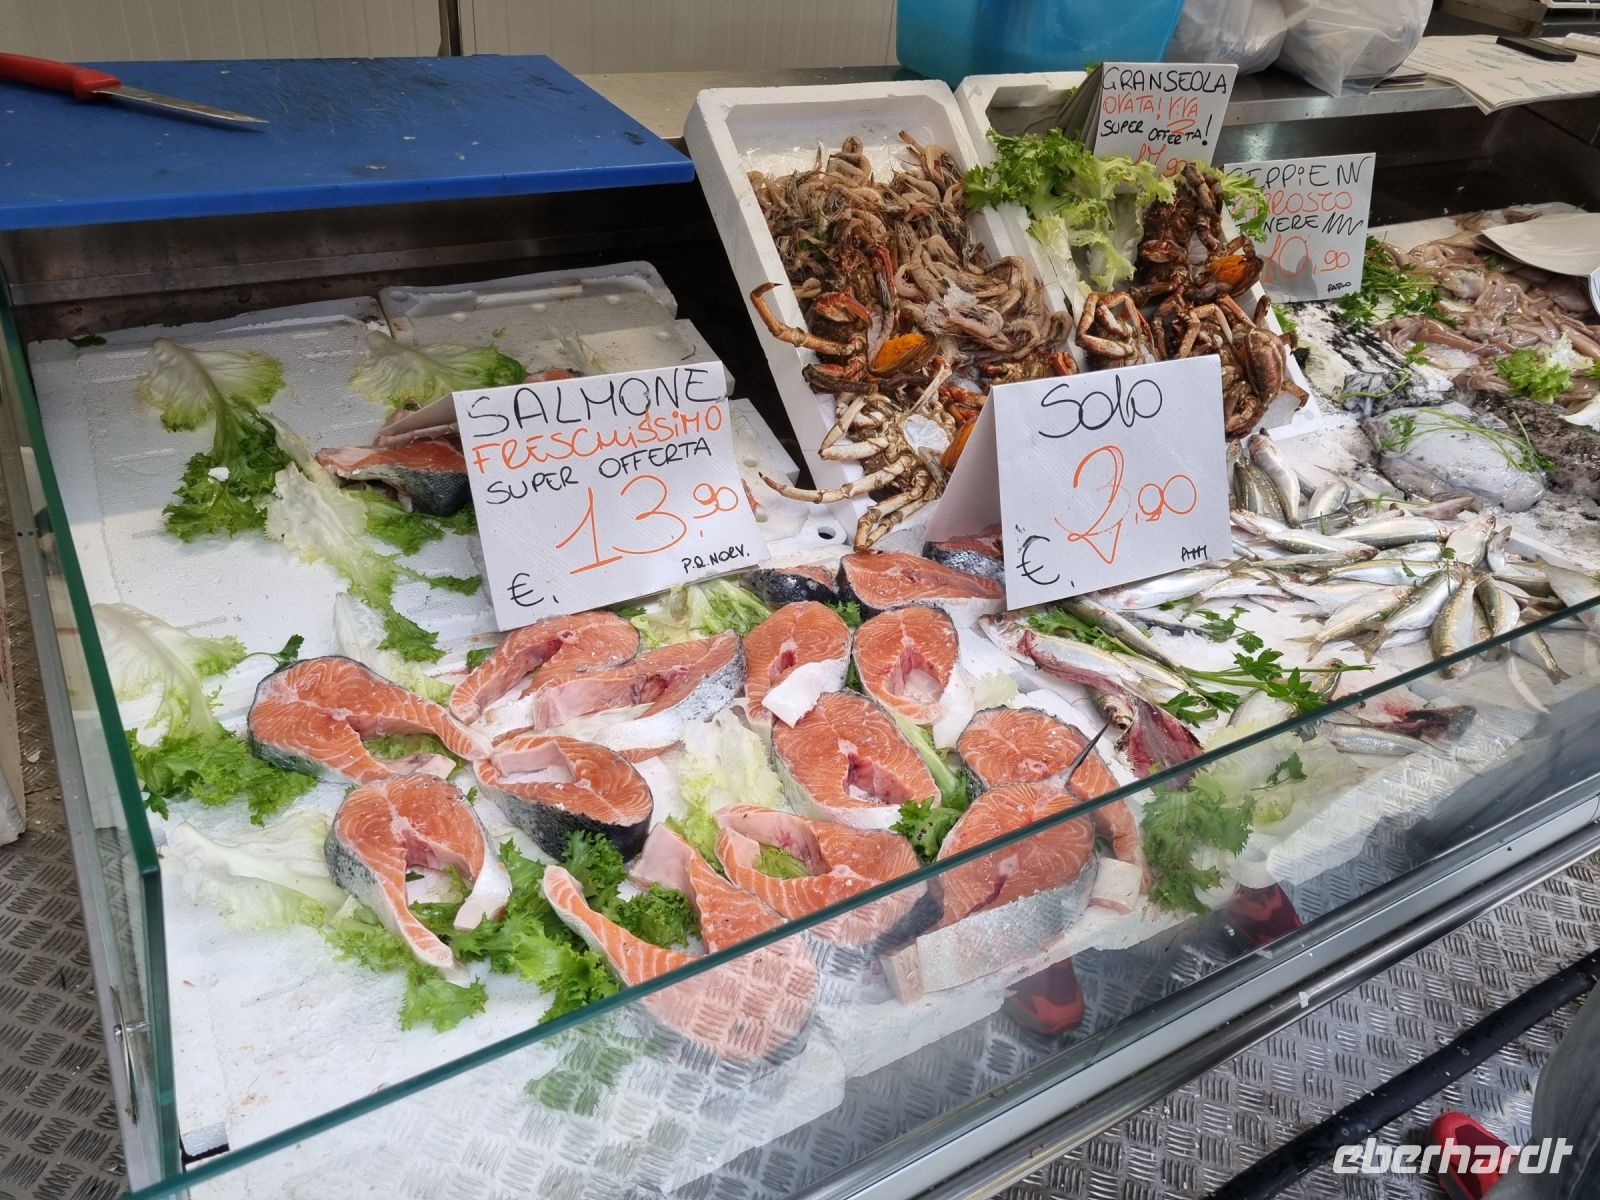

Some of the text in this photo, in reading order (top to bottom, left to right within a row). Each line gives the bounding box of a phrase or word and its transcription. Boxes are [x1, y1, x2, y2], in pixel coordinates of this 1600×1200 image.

[1102, 67, 1227, 94] GRANSEOLA
[1101, 120, 1143, 137] SUPER
[468, 367, 724, 437] SALMONE
[1038, 374, 1163, 438] Solo
[486, 437, 712, 504] SUPER OFFERTA
